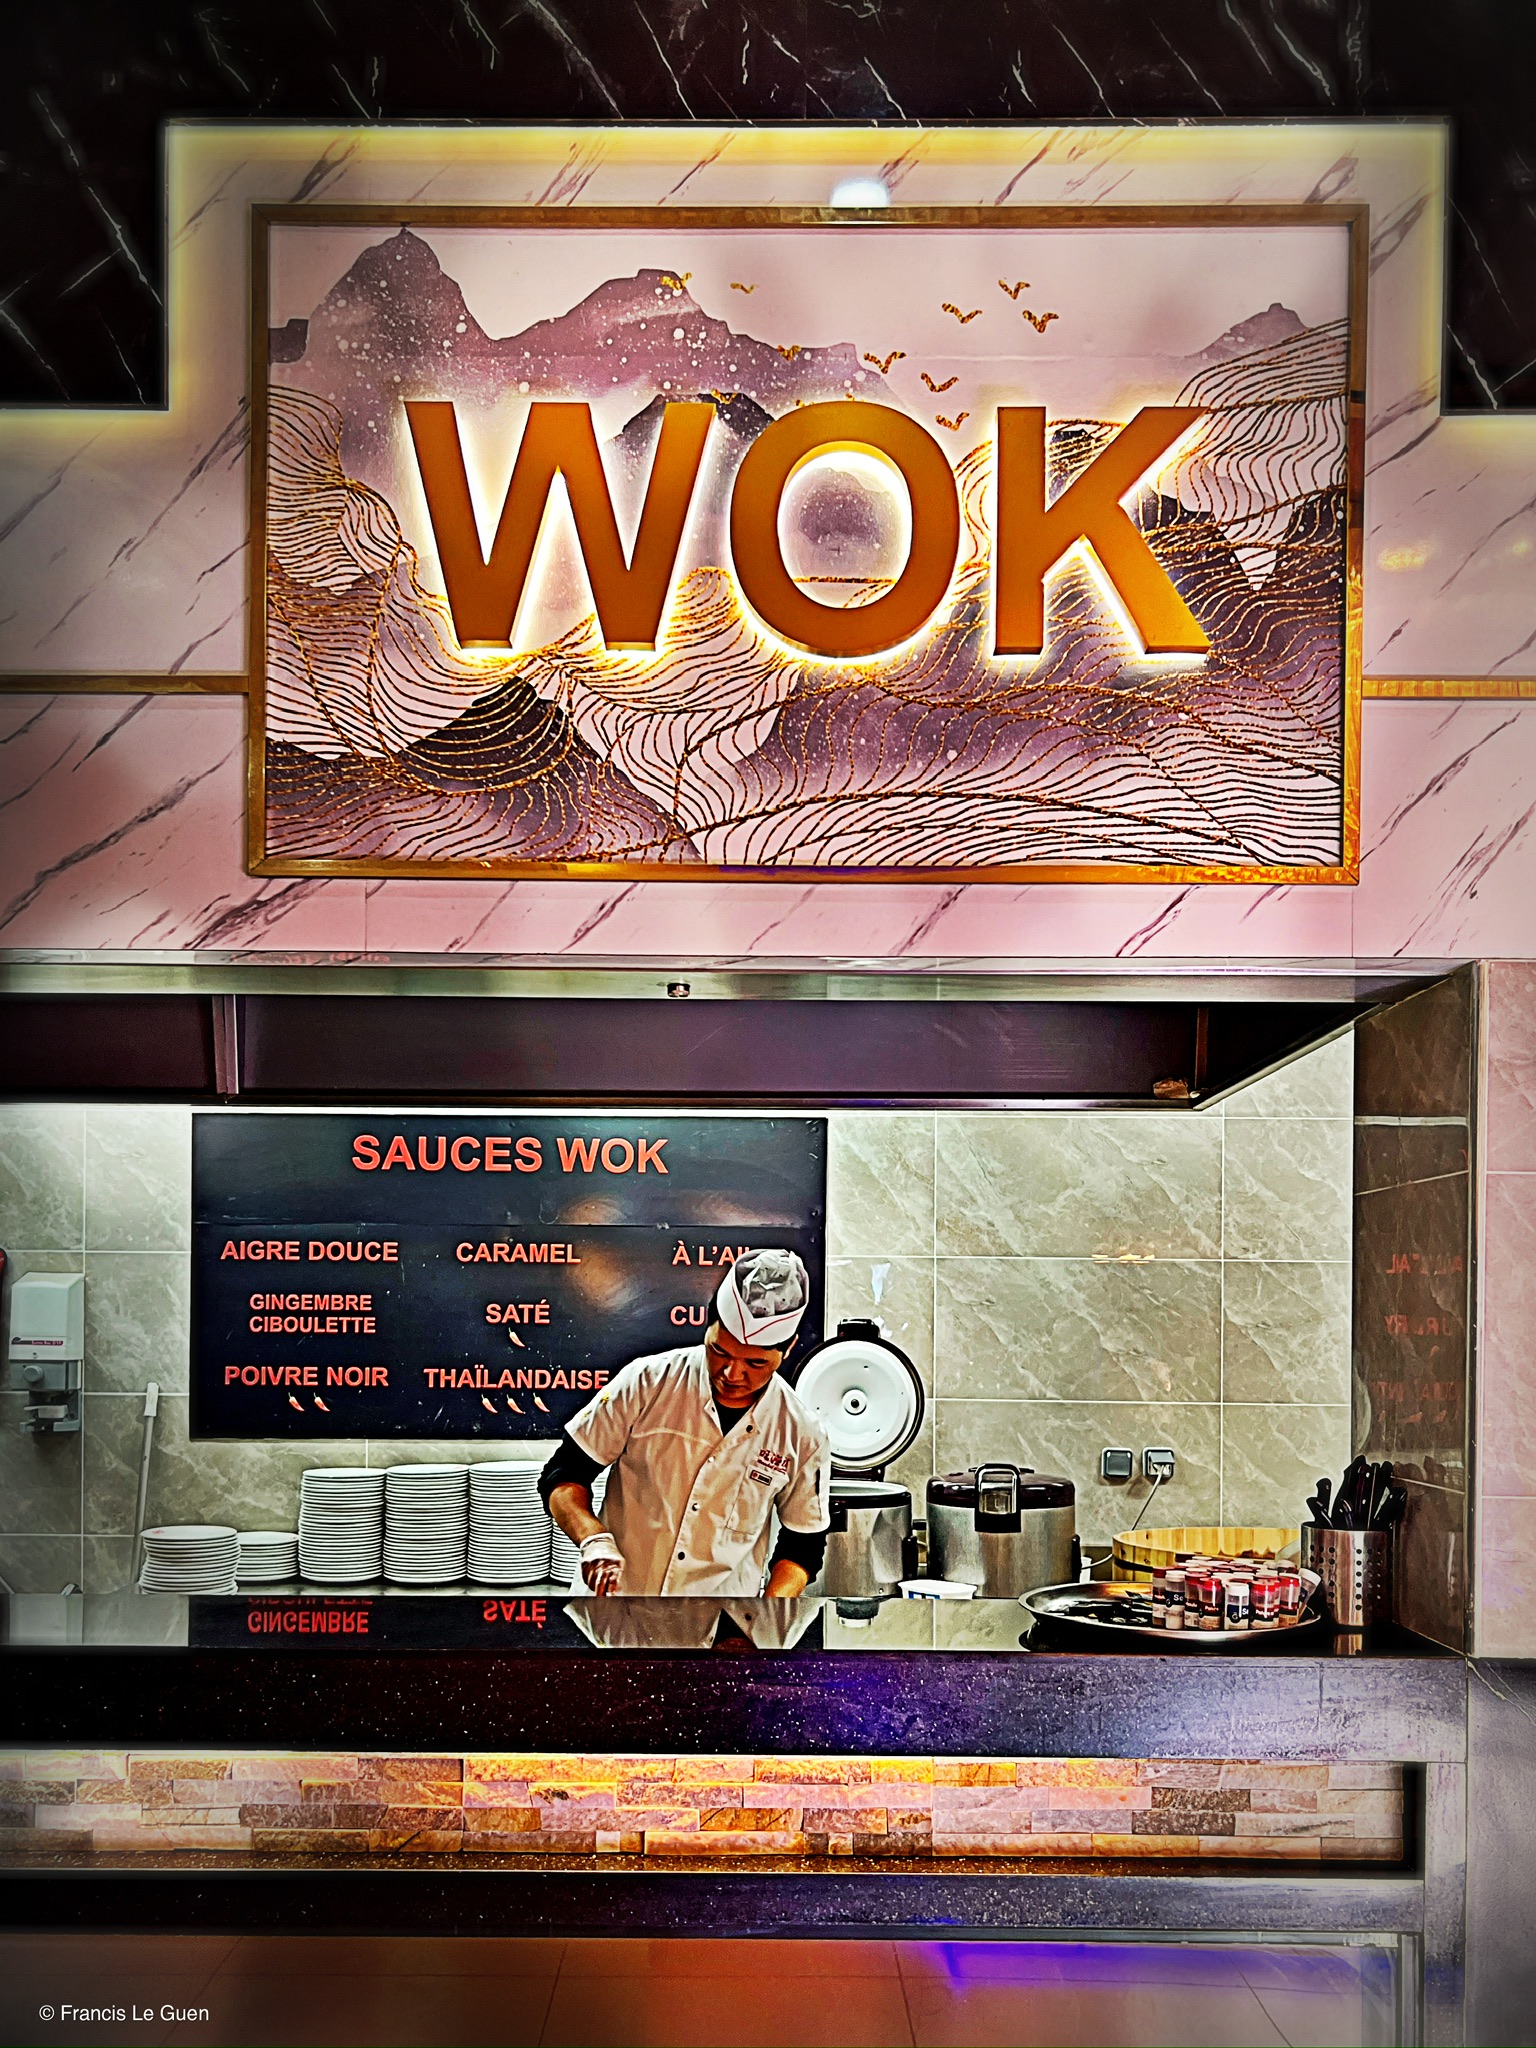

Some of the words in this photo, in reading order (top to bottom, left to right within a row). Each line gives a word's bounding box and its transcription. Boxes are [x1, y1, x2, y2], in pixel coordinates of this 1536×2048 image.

[405, 399, 1210, 656] WOK
[351, 1134, 543, 1173] SAUCES
[556, 1137, 669, 1175] WOK
[220, 1240, 301, 1262] AIGRE
[308, 1241, 399, 1263] DOUCE
[456, 1242, 581, 1264] CARAMEL
[672, 1240, 691, 1266] À
[249, 1293, 372, 1311] GINGEMBRE
[485, 1300, 550, 1325] SATÉ
[249, 1315, 376, 1334] CIBOULETTE
[224, 1365, 319, 1387] POIVRE
[326, 1366, 389, 1388] NOIR
[424, 1364, 609, 1391] THAÏLANDAISE
